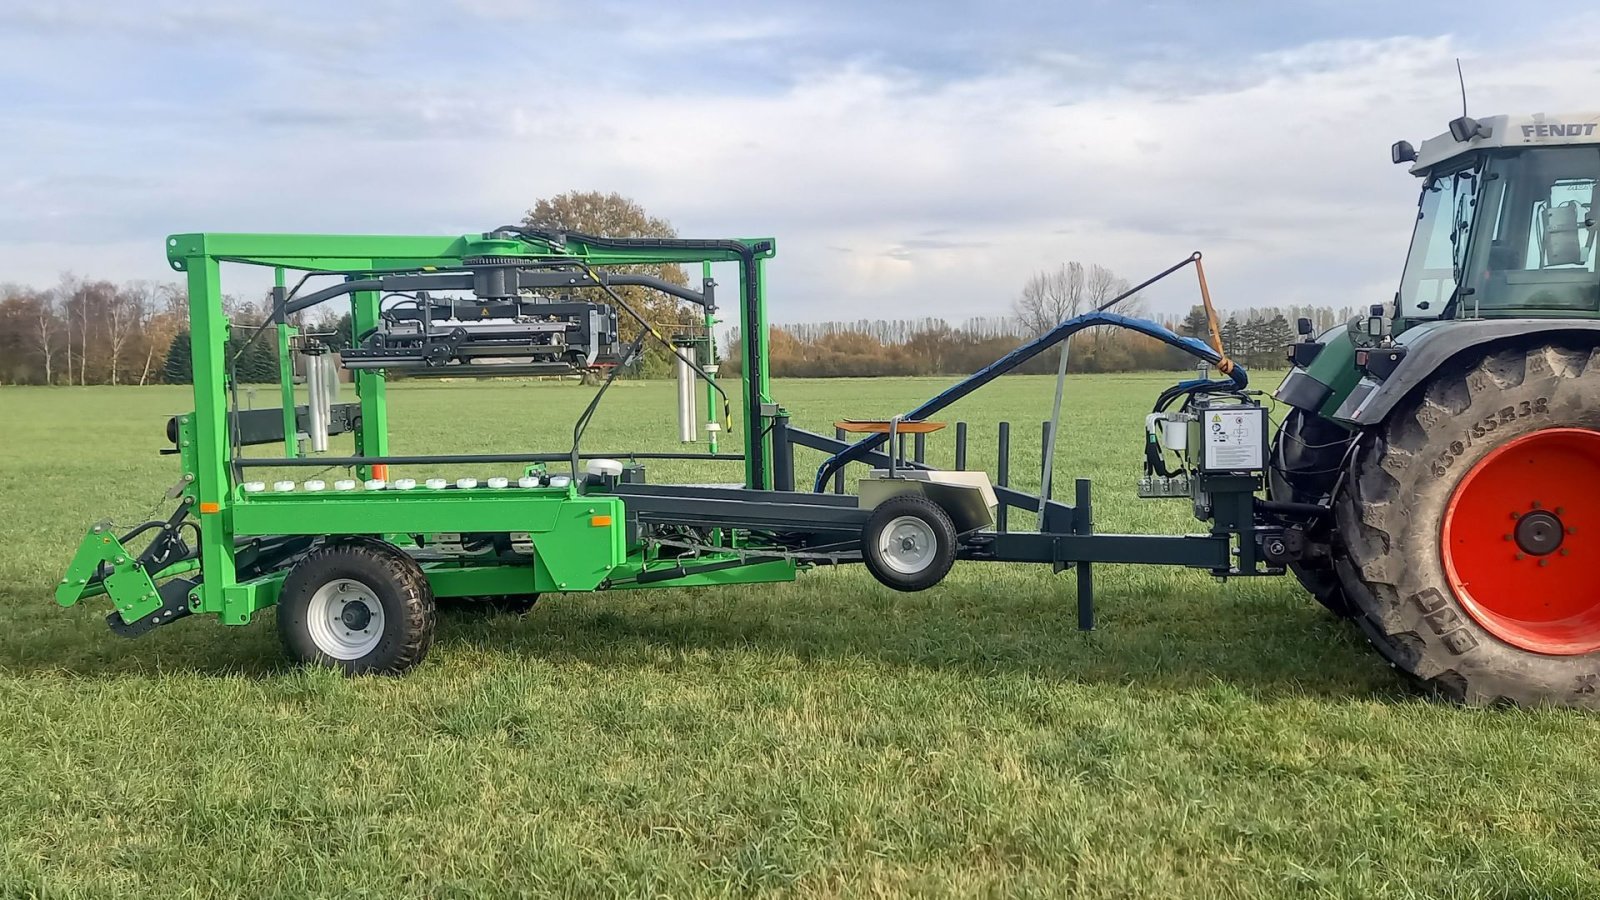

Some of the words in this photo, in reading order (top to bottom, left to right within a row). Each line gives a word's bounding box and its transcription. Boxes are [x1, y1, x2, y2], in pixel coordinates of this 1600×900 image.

[1520, 123, 1598, 138] FENDT
[1431, 397, 1550, 478] 650/65R38
[1411, 587, 1479, 656] BKT
